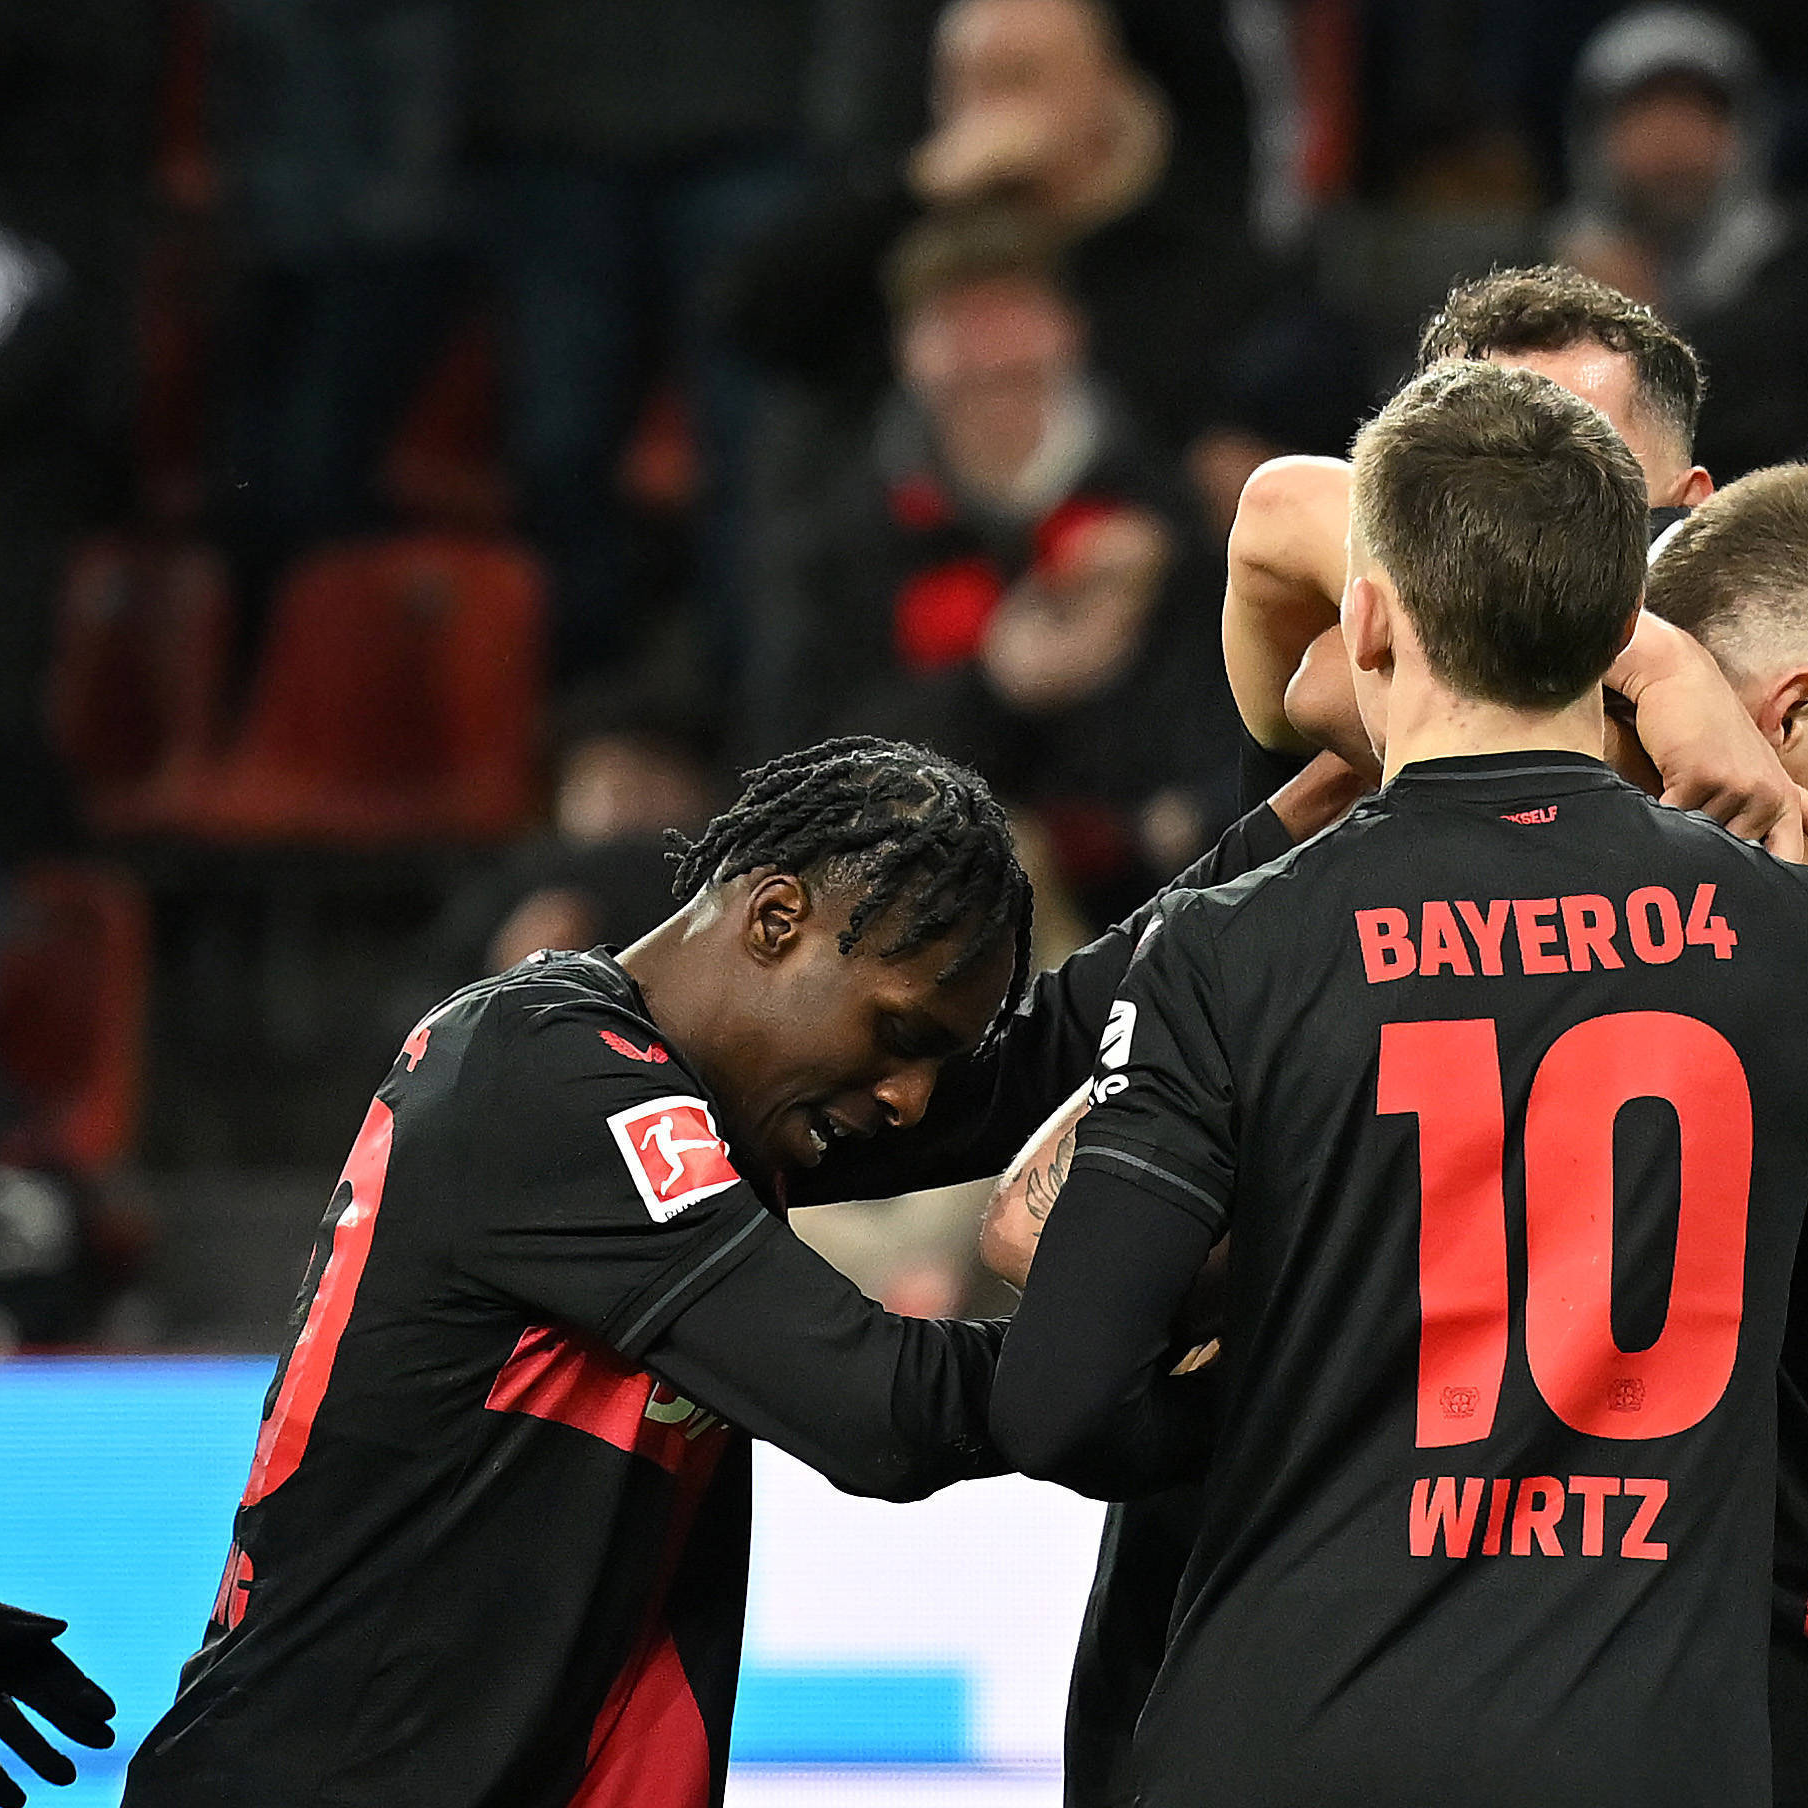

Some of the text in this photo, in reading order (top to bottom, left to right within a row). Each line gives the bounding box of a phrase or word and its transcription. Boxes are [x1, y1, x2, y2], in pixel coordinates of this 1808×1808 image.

[1355, 883, 1739, 984] BAYER 04
[1376, 1010, 1754, 1449] 10
[1409, 1476, 1669, 1561] WIRTZ
